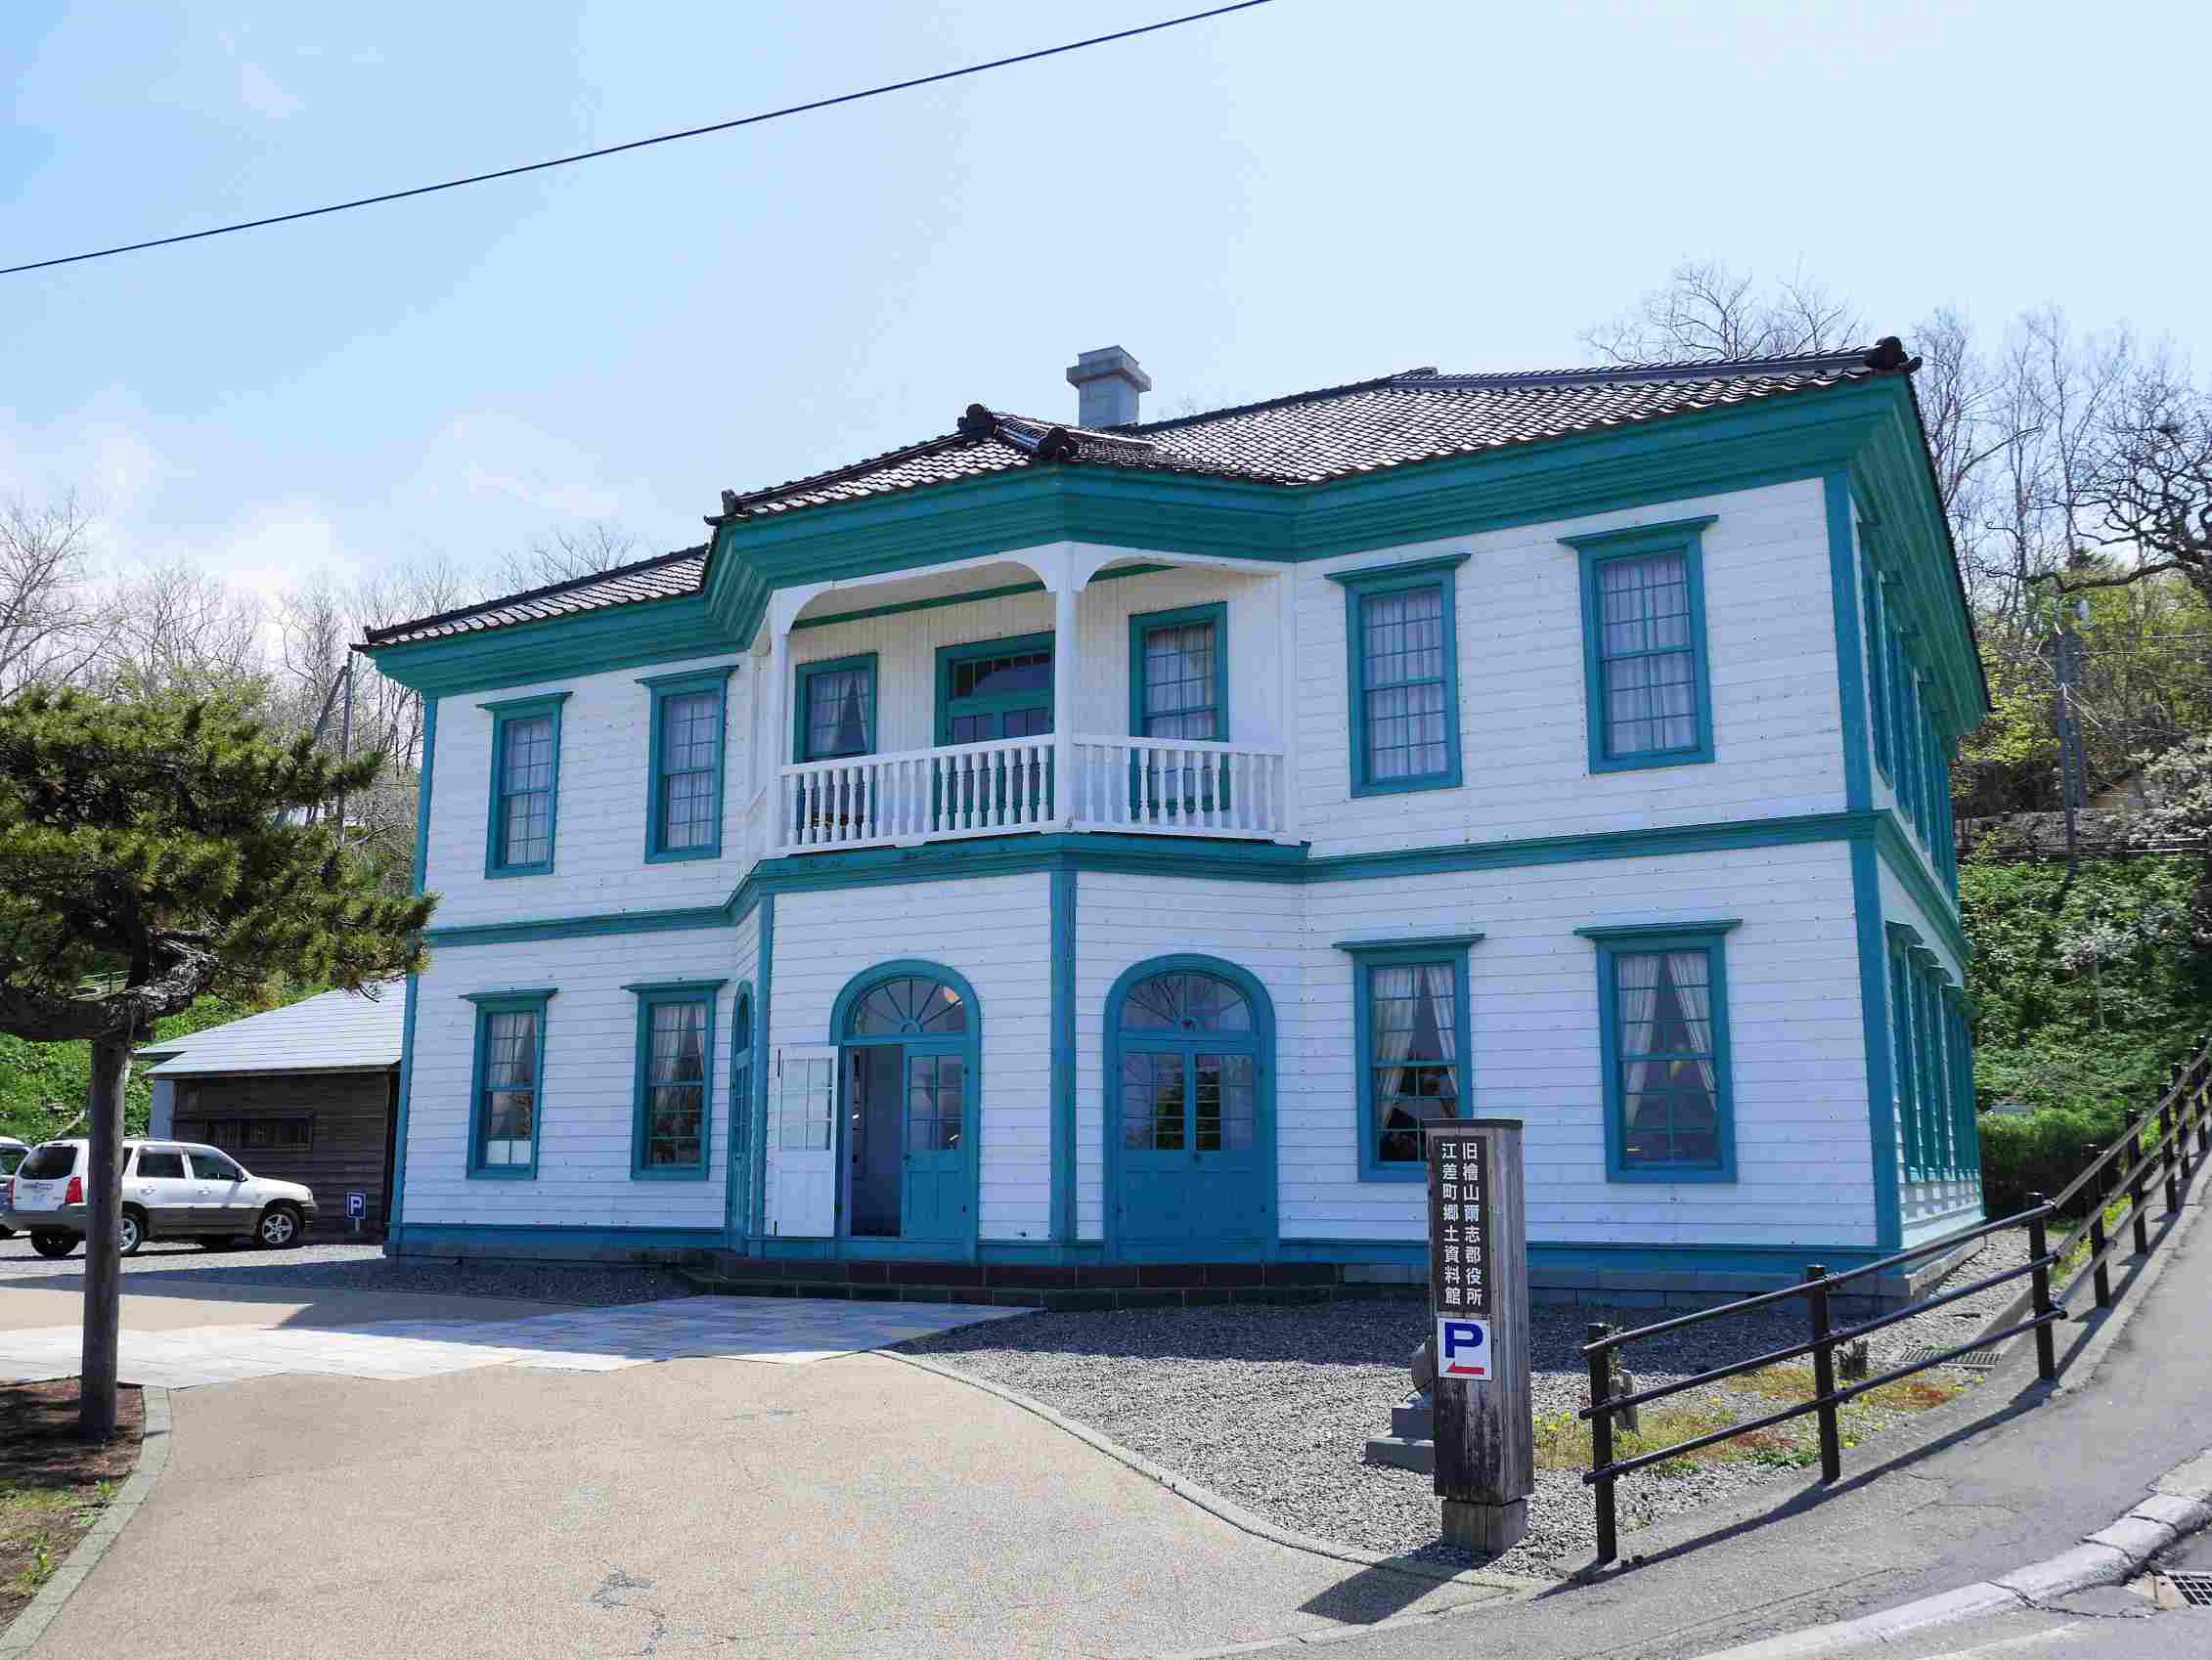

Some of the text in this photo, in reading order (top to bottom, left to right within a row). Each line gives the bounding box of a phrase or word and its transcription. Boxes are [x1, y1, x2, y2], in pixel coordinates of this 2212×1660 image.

[350, 1196, 363, 1215] P
[1441, 1142, 1461, 1305] 江差町郷土資料館
[1462, 1142, 1482, 1307] 旧檜山爾志郡役所
[1444, 1322, 1483, 1358] P
